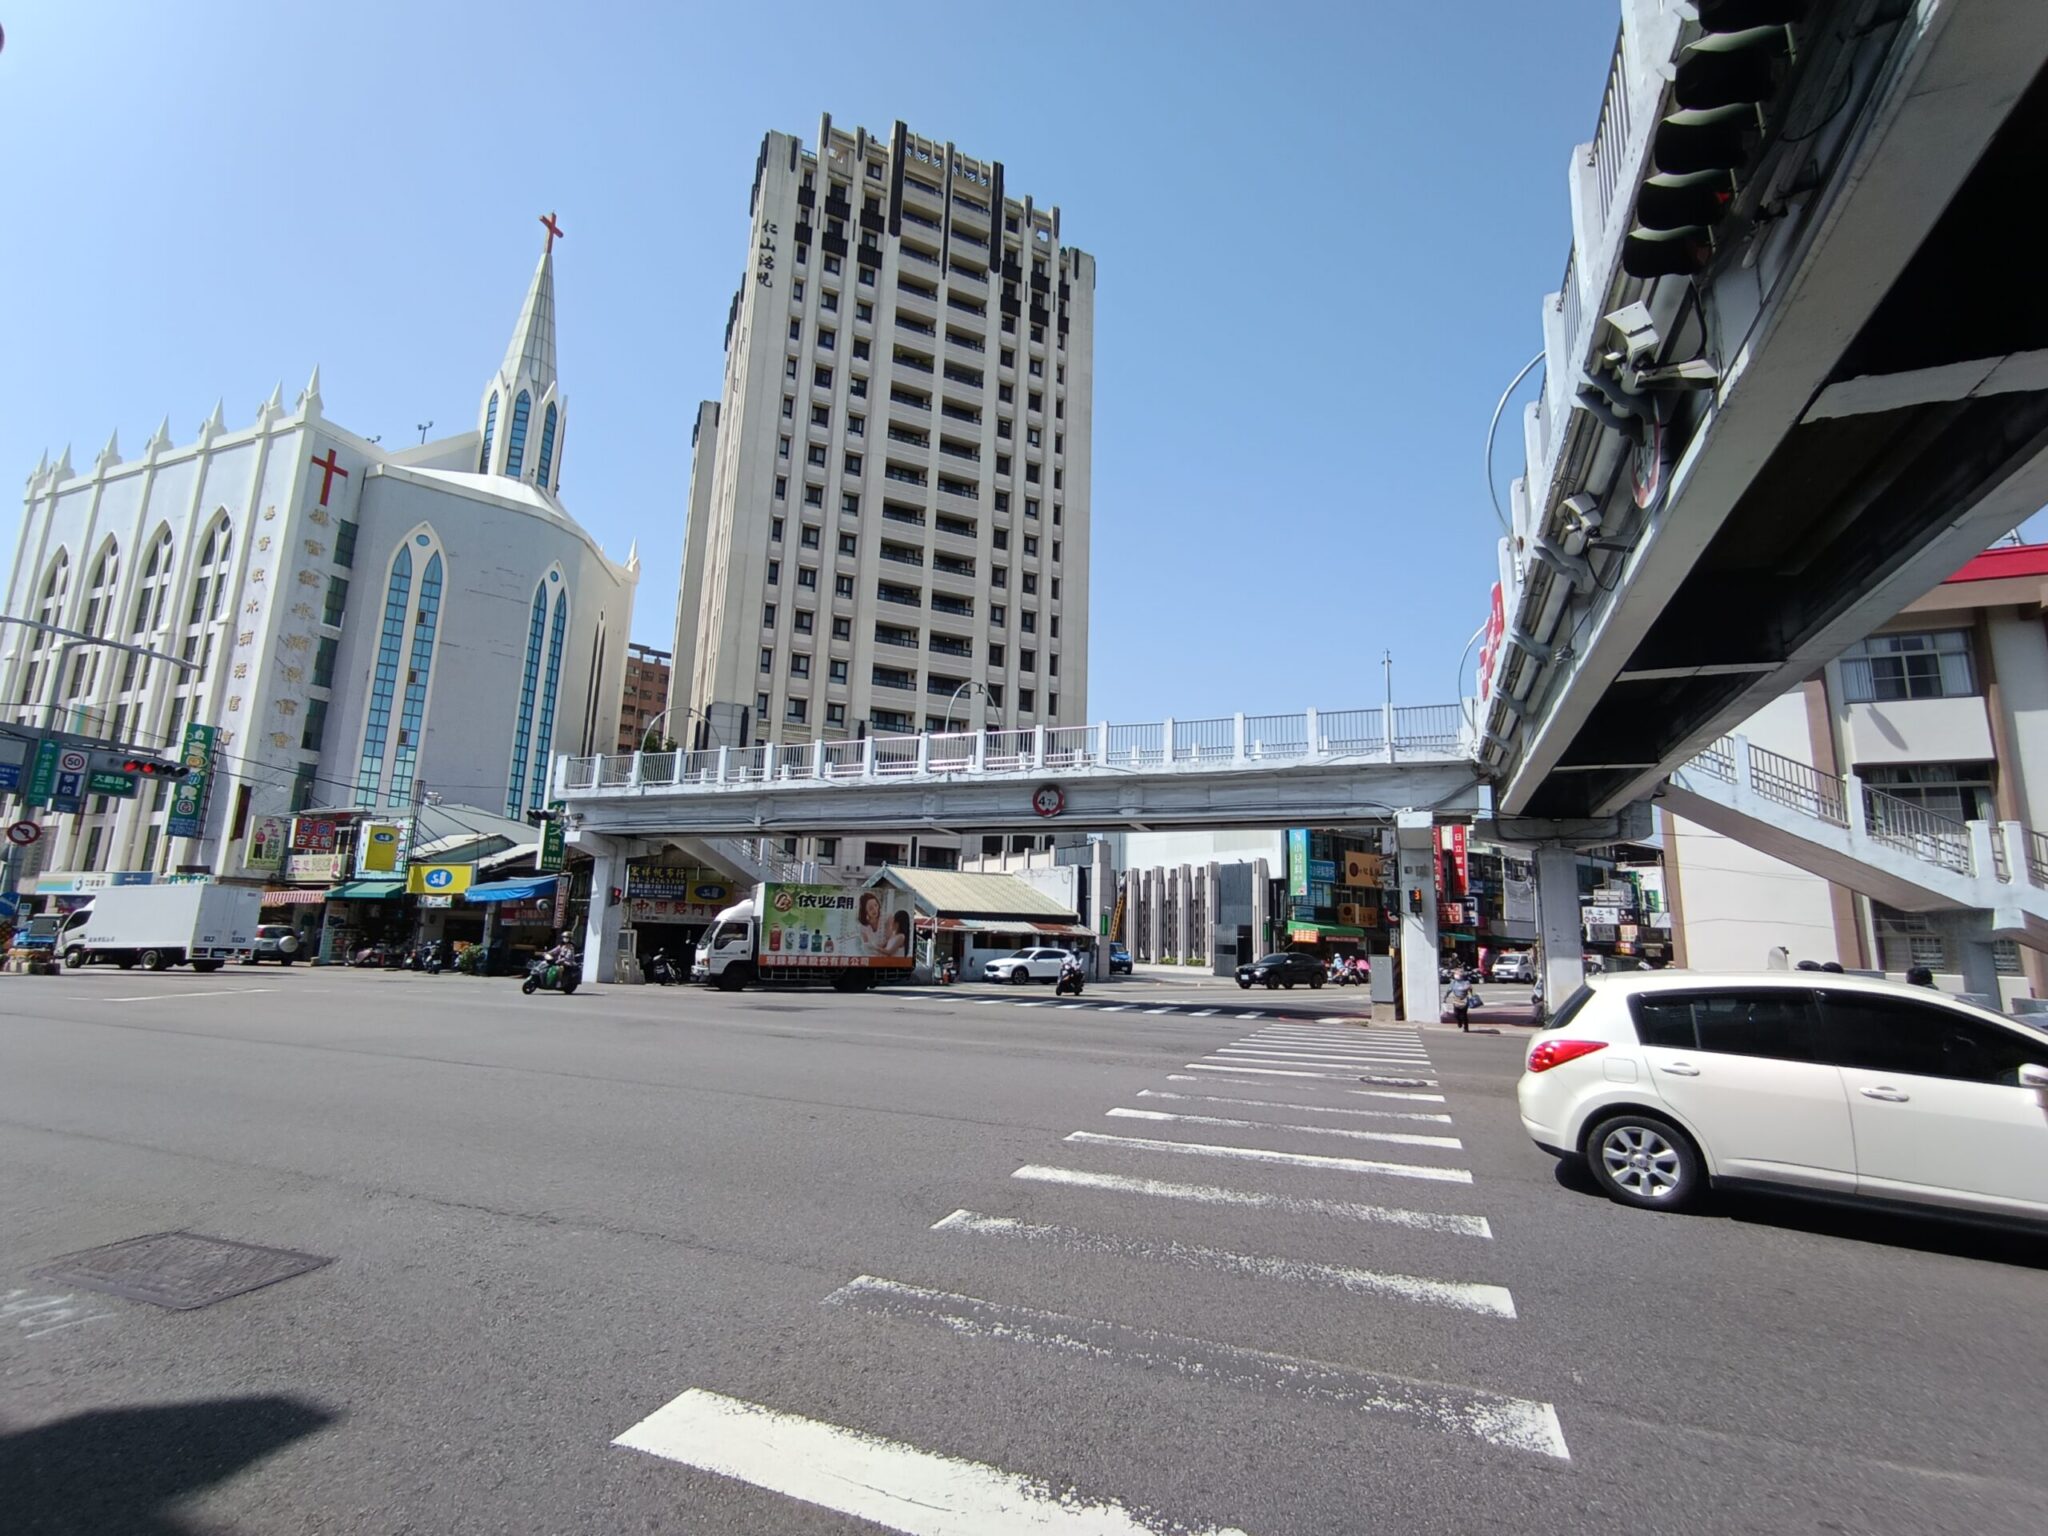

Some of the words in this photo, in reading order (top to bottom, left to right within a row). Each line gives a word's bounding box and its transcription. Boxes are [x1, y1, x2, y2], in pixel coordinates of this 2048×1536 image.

[67, 758, 81, 767] 50
[61, 774, 75, 794] 學校
[798, 894, 854, 910] 依必朗
